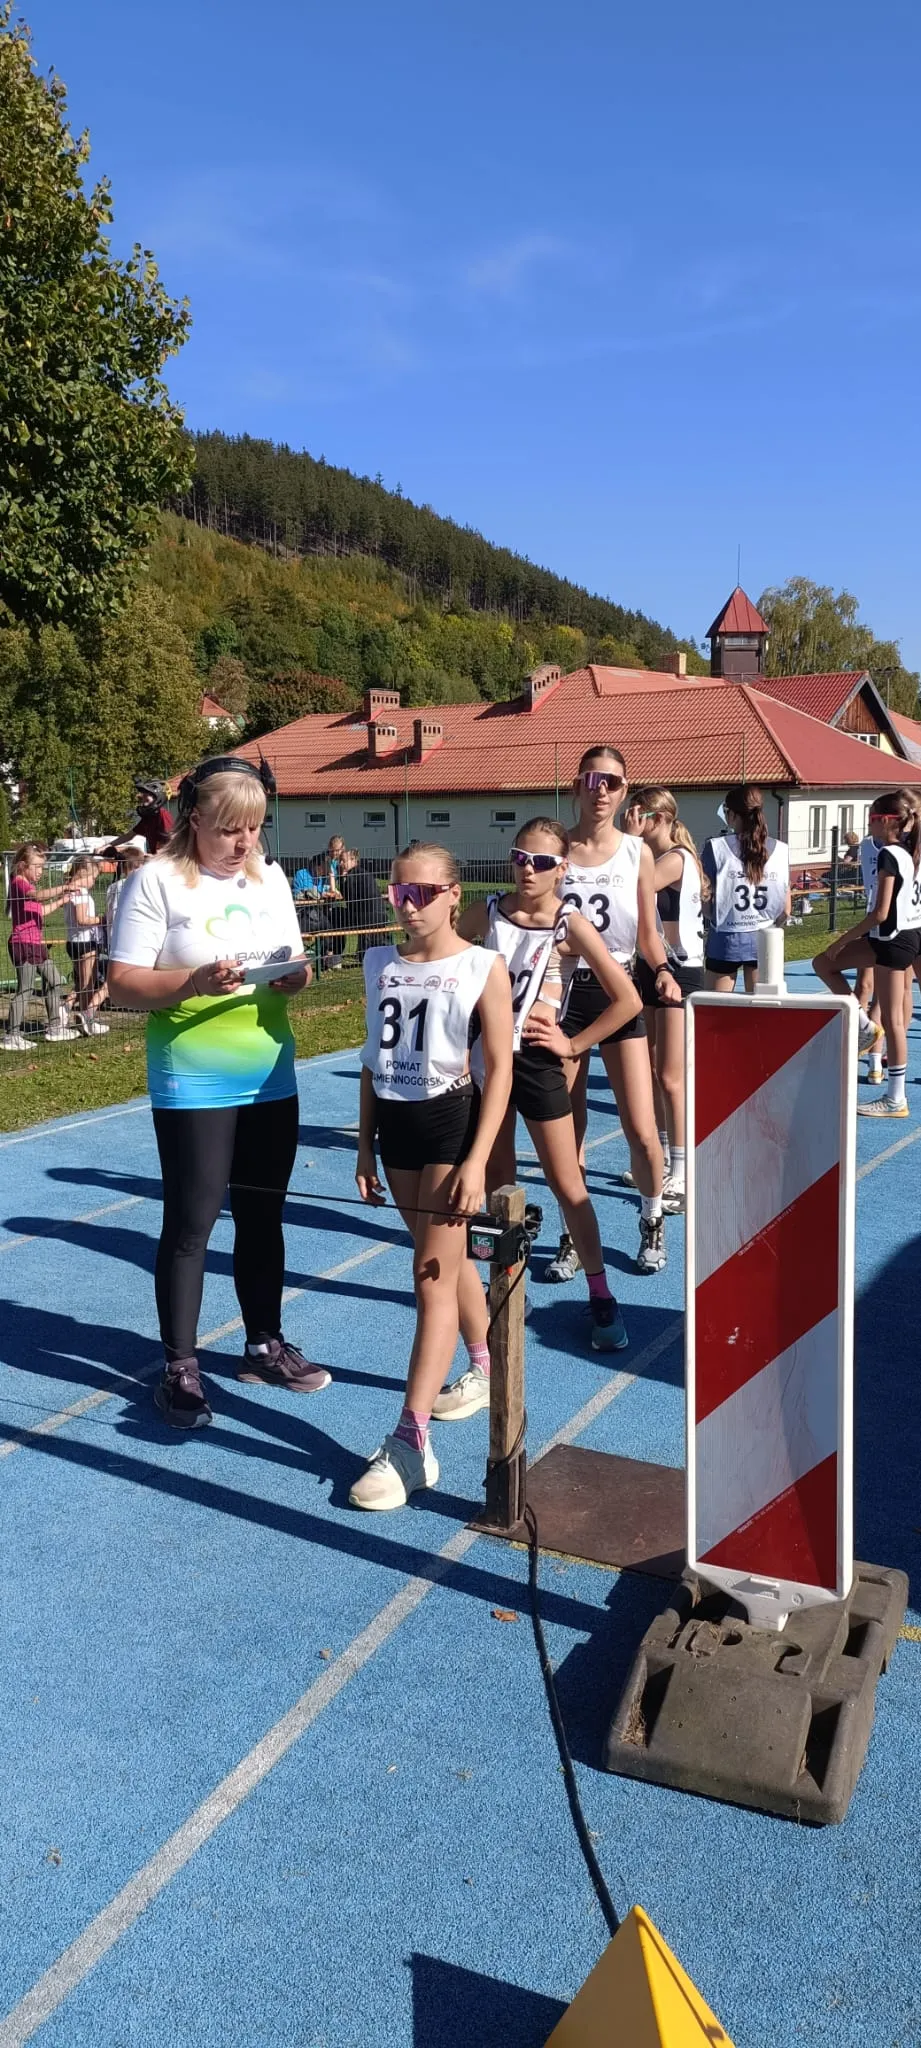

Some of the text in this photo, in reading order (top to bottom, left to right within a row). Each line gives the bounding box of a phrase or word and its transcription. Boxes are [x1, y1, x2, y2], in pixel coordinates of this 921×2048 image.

[734, 884, 768, 911] 35
[911, 880, 921, 906] 3
[378, 997, 430, 1052] 31
[386, 1060, 422, 1072] POWIAT
